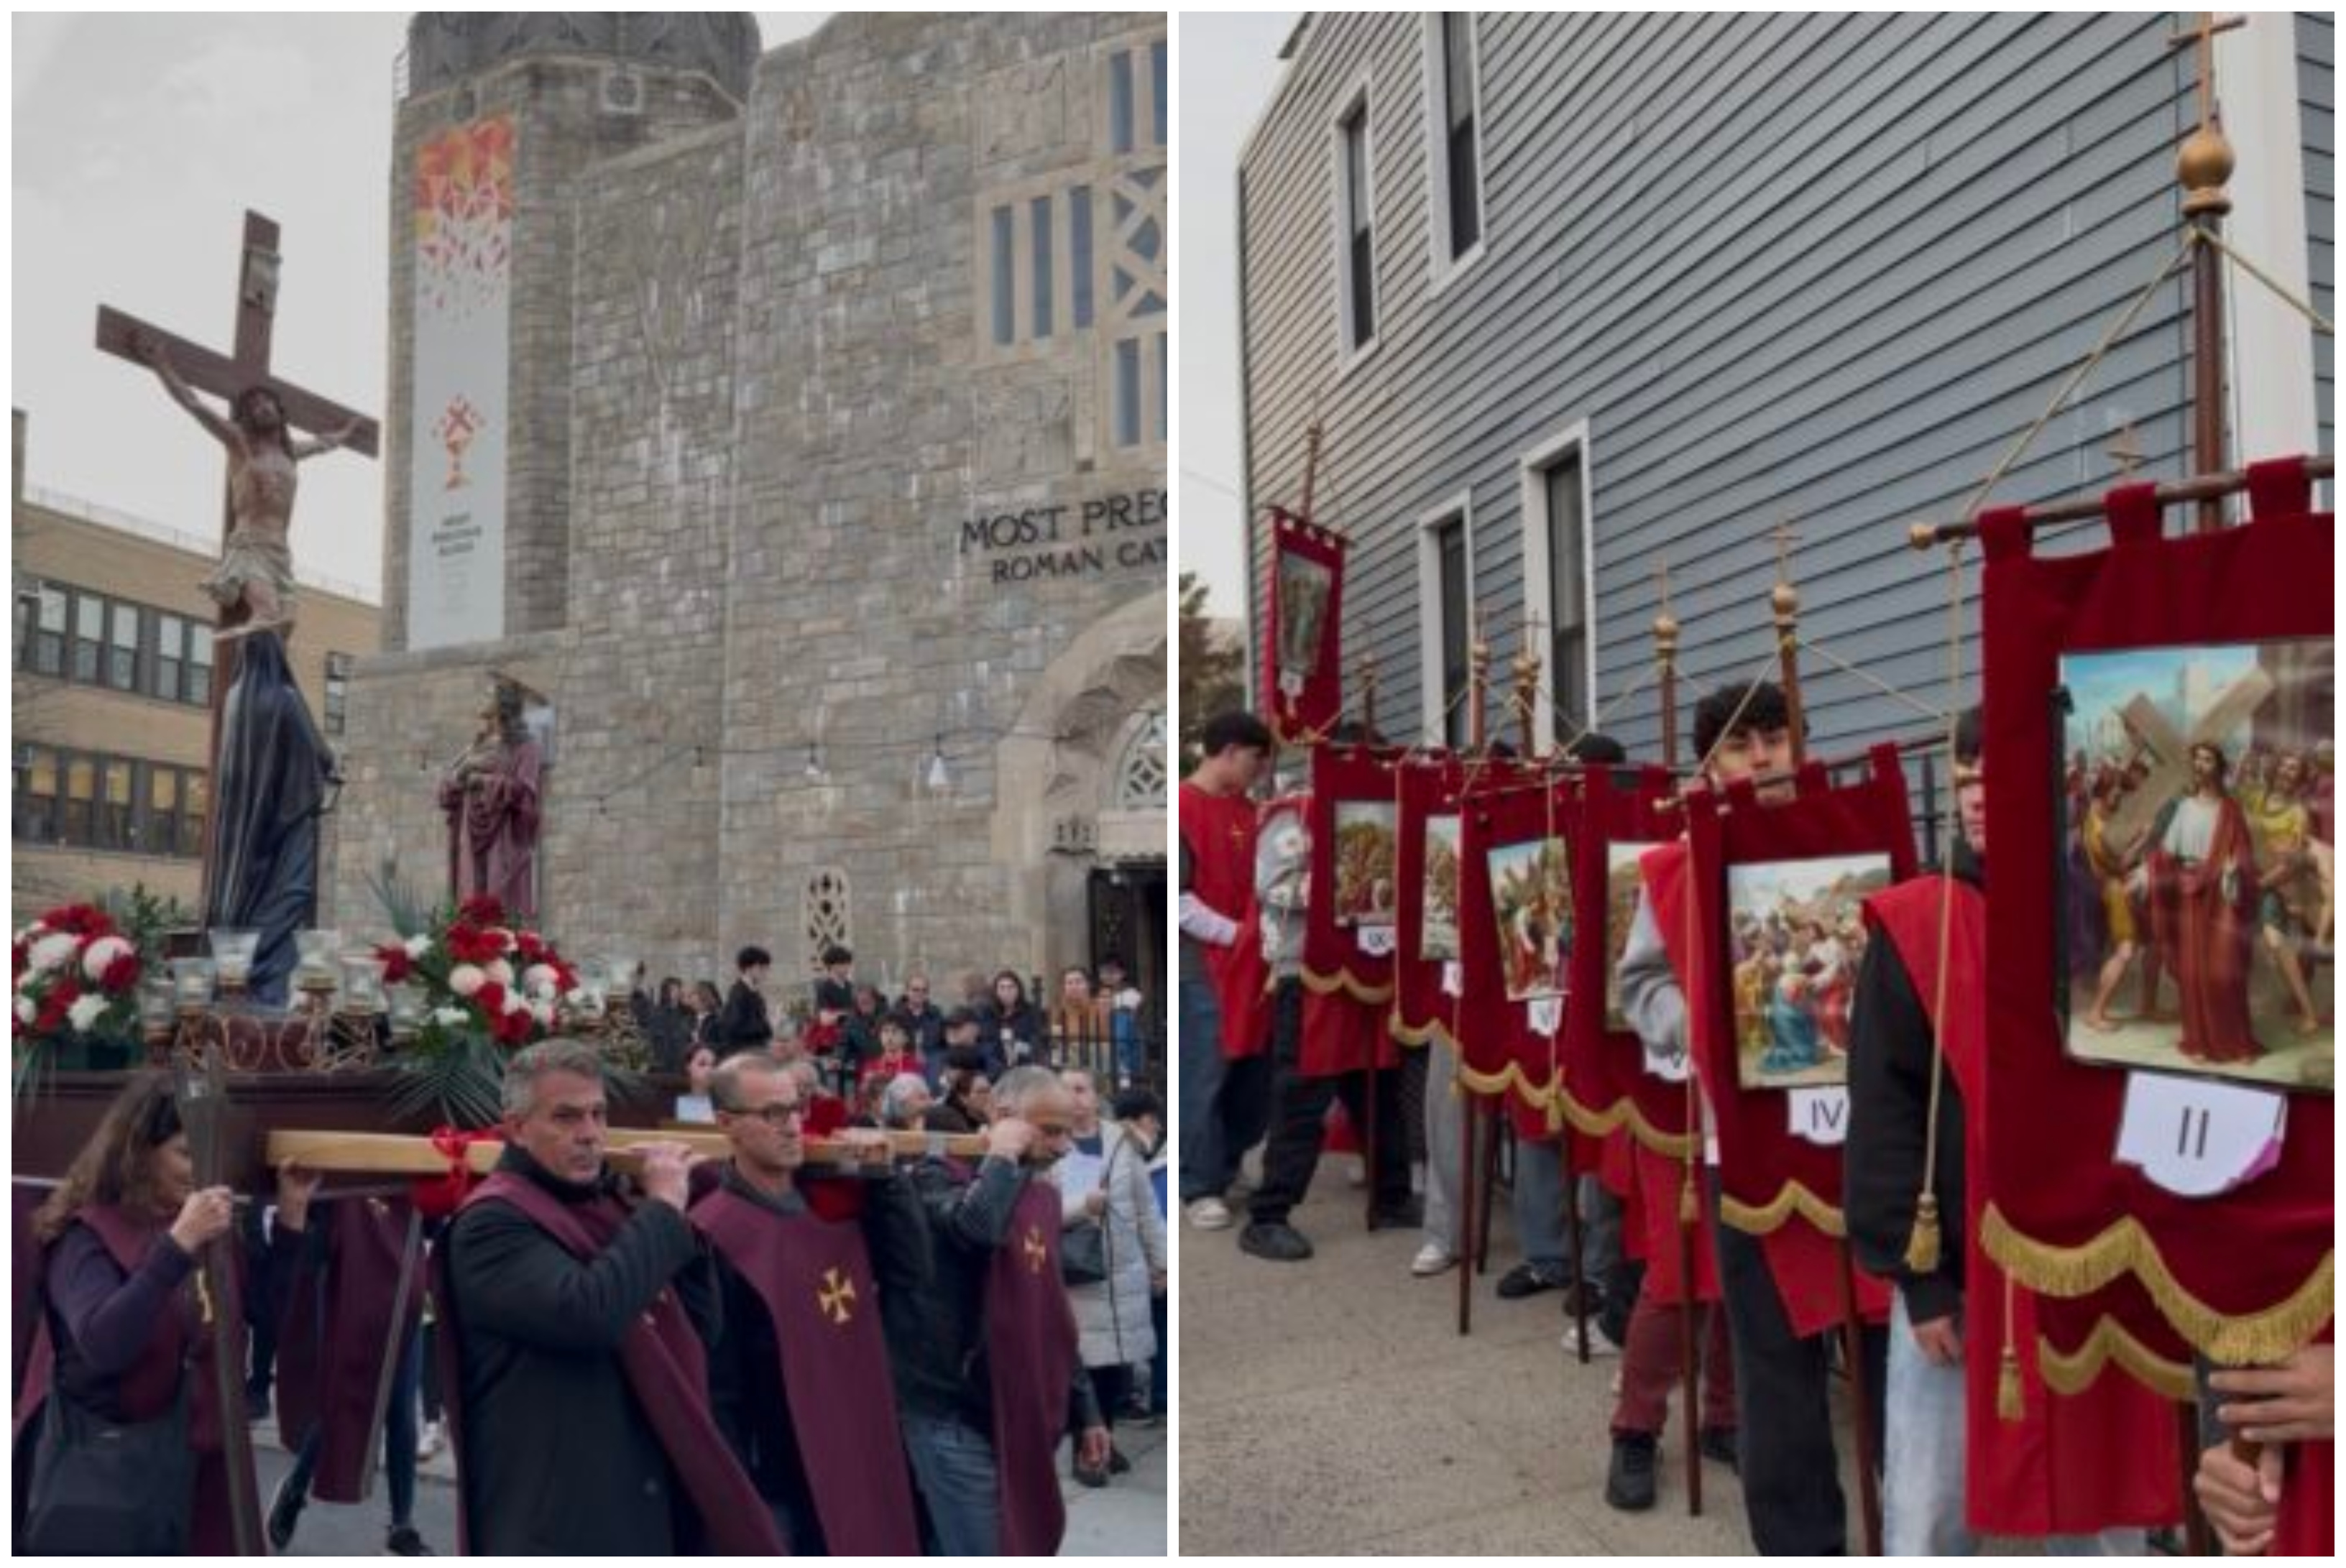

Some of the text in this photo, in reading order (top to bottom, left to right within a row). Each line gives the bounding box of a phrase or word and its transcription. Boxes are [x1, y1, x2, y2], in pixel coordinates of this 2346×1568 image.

[960, 504, 1068, 554] MOST
[992, 545, 1104, 584] ROMAN
[1812, 1098, 1844, 1131] IV
[2178, 1105, 2210, 1159] II
